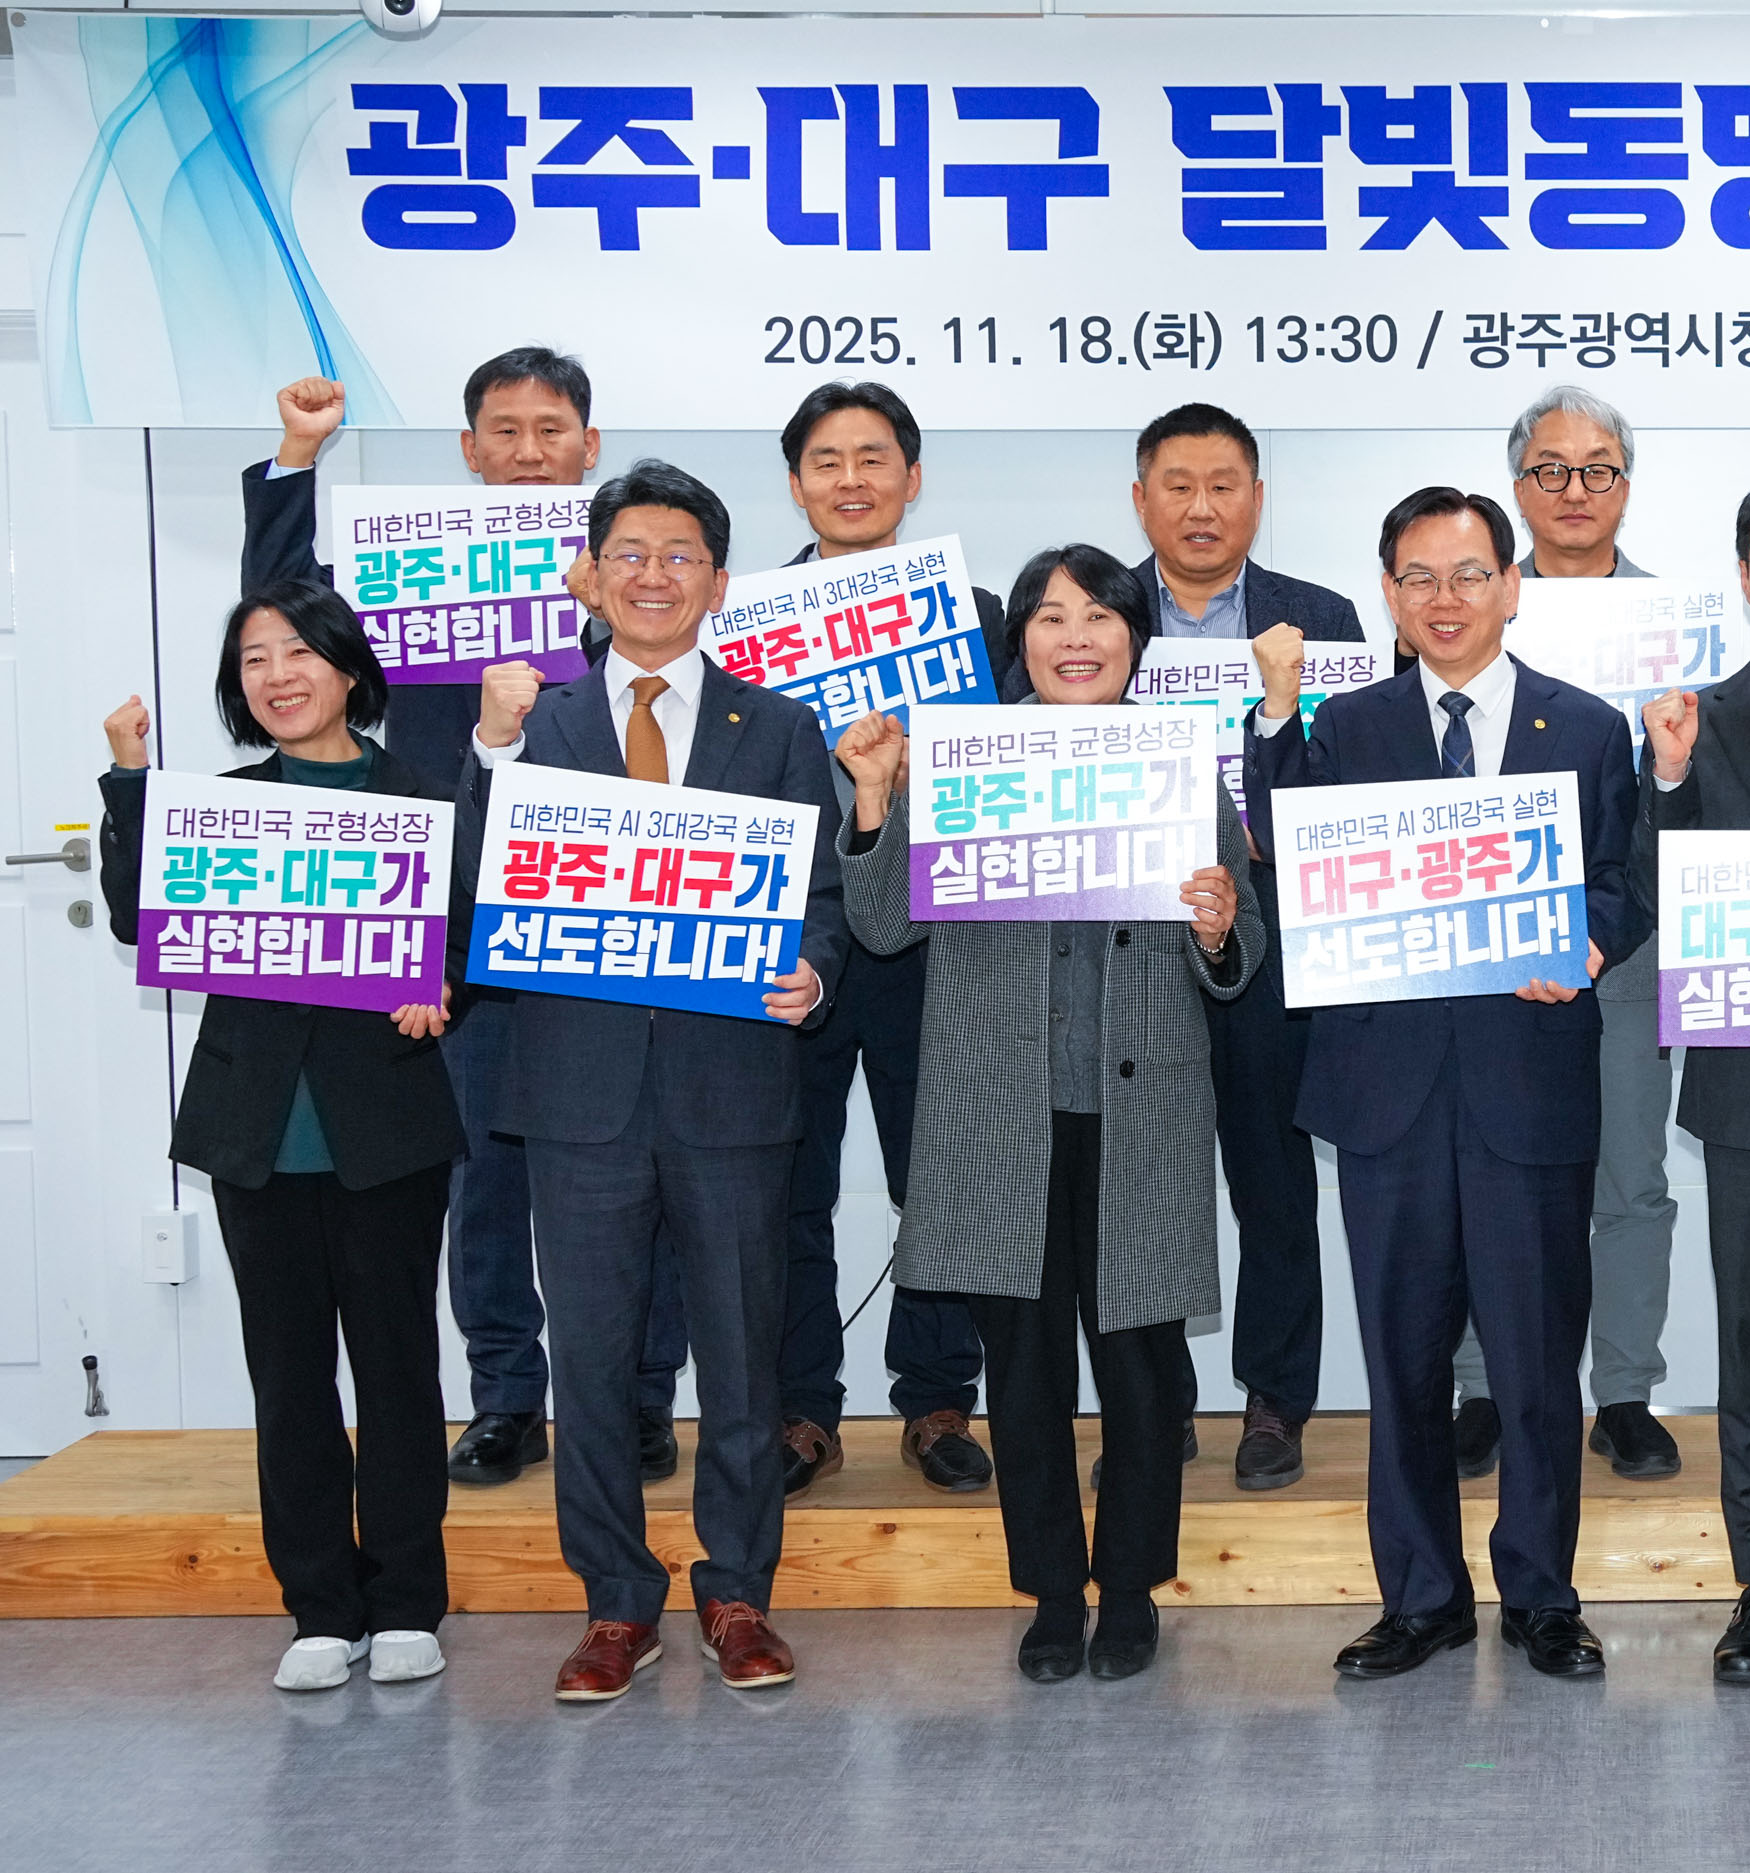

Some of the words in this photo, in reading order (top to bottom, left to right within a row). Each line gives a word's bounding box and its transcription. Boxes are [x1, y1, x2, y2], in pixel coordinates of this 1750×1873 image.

[345, 82, 1111, 251] 광주·대구
[763, 315, 916, 365] 2025.
[943, 315, 1022, 366] 11.
[1048, 310, 1223, 371] 18.(화)
[1246, 313, 1398, 364] 13:30
[353, 508, 473, 545] 대한민국
[711, 593, 796, 638] 대한민국
[802, 586, 820, 613] AI
[823, 564, 899, 606] 3대강국
[904, 550, 948, 583] 실현
[1682, 591, 1725, 620] 실현
[1134, 662, 1250, 695] 대한민국
[931, 729, 1058, 769] 대한민국
[1069, 718, 1198, 758] 균형성장
[166, 807, 293, 840] 대한민국
[304, 809, 434, 843] 균형성장
[509, 803, 613, 836] 대한민국
[617, 809, 641, 837] AI
[646, 810, 739, 842] 3대강국
[745, 816, 796, 846] 실현
[931, 755, 1199, 835] 광주·대구가
[1295, 813, 1389, 853] 대한민국
[1396, 809, 1416, 839] AI
[1422, 796, 1505, 835] 3대강국
[1512, 787, 1559, 821] 실현
[162, 846, 431, 909] 광주·대구가
[502, 839, 790, 912] 광주·대구가
[1298, 823, 1564, 918] 대구·광주가
[156, 914, 426, 979] 실현합니다!
[487, 911, 784, 984] 선도합니다!
[1301, 892, 1572, 993] 선도합니다!
